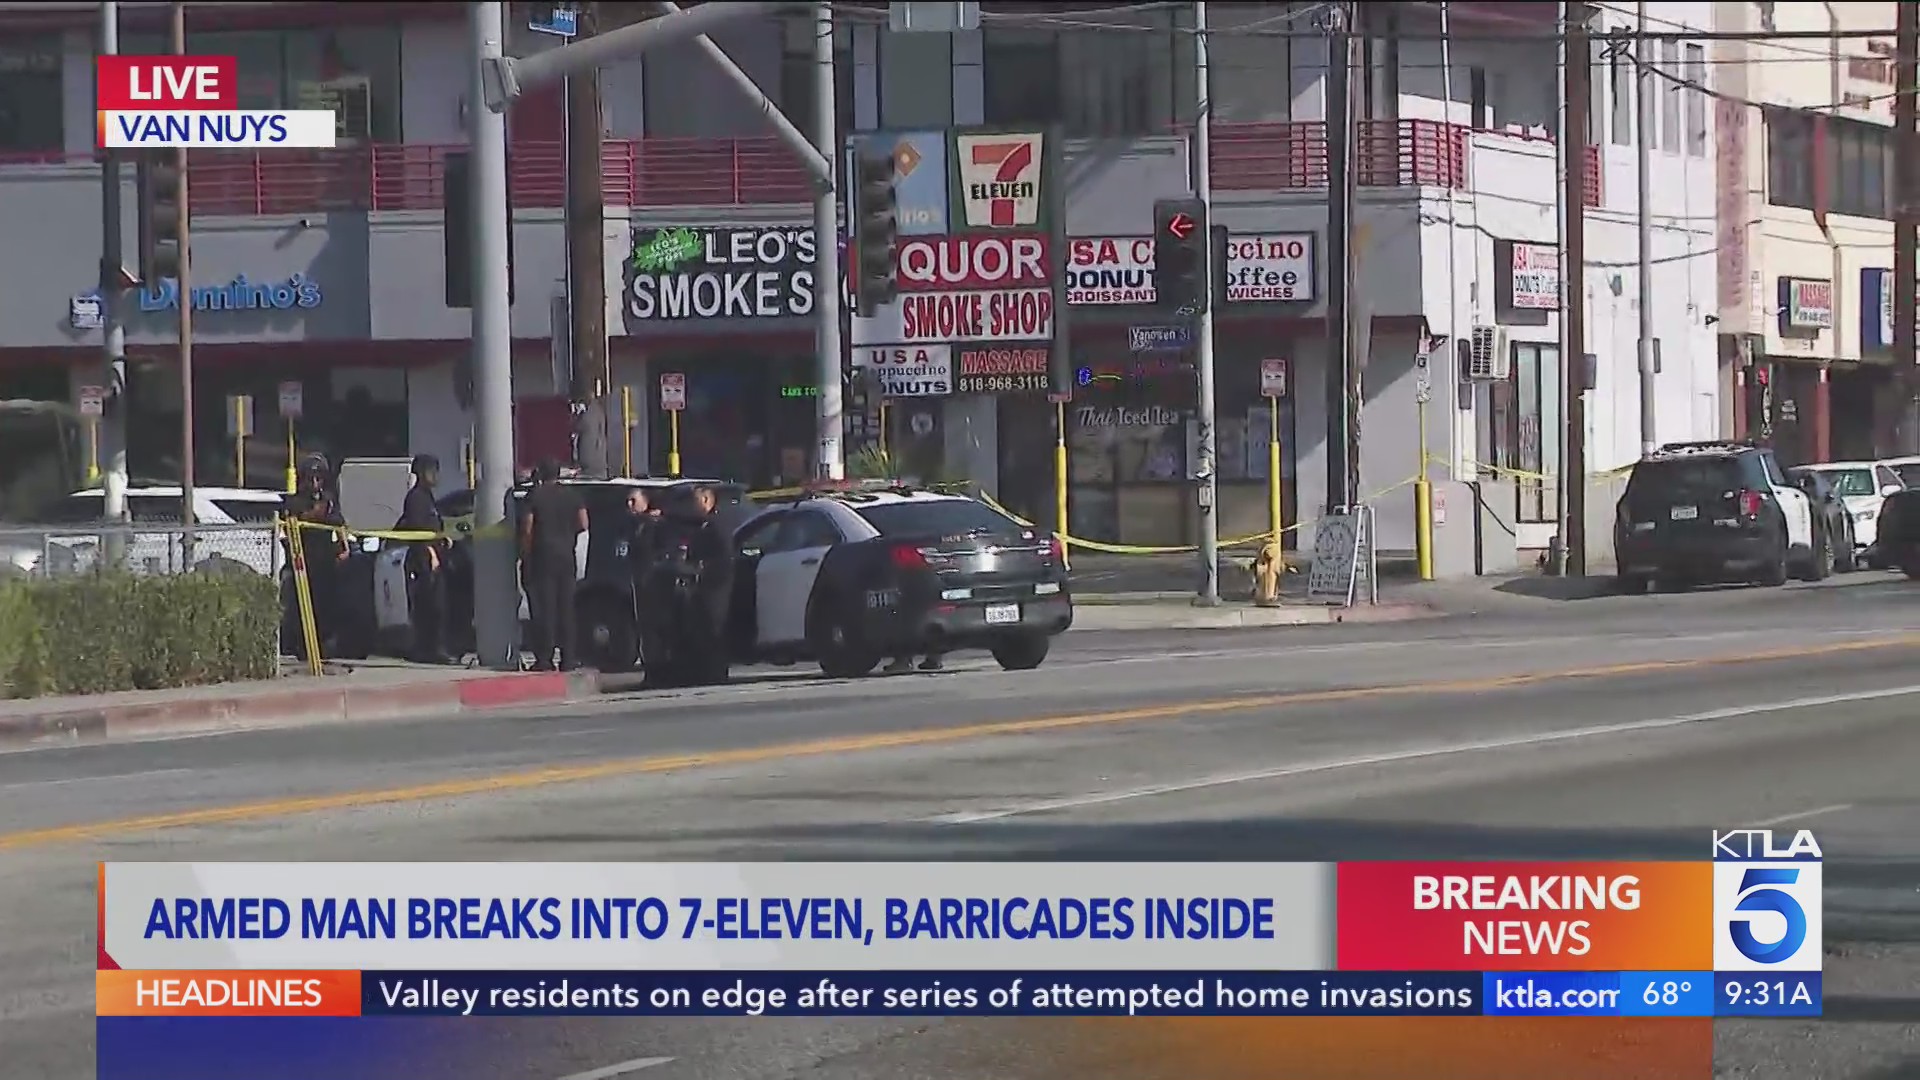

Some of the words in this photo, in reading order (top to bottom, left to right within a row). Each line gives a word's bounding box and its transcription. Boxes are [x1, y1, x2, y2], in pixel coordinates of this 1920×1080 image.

[705, 231, 815, 263] LEO'S
[899, 239, 1045, 282] QUOR
[1066, 269, 1156, 289] DONUT
[1227, 267, 1297, 286] offee
[140, 272, 321, 311] Dmino's
[1228, 287, 1294, 299] WICHES
[903, 294, 984, 339] SMOKE
[990, 291, 1052, 336] SHOP
[878, 364, 947, 379] ppuccino
[959, 350, 1048, 375] MASSAGE
[959, 375, 1048, 392] 818-968-3118
